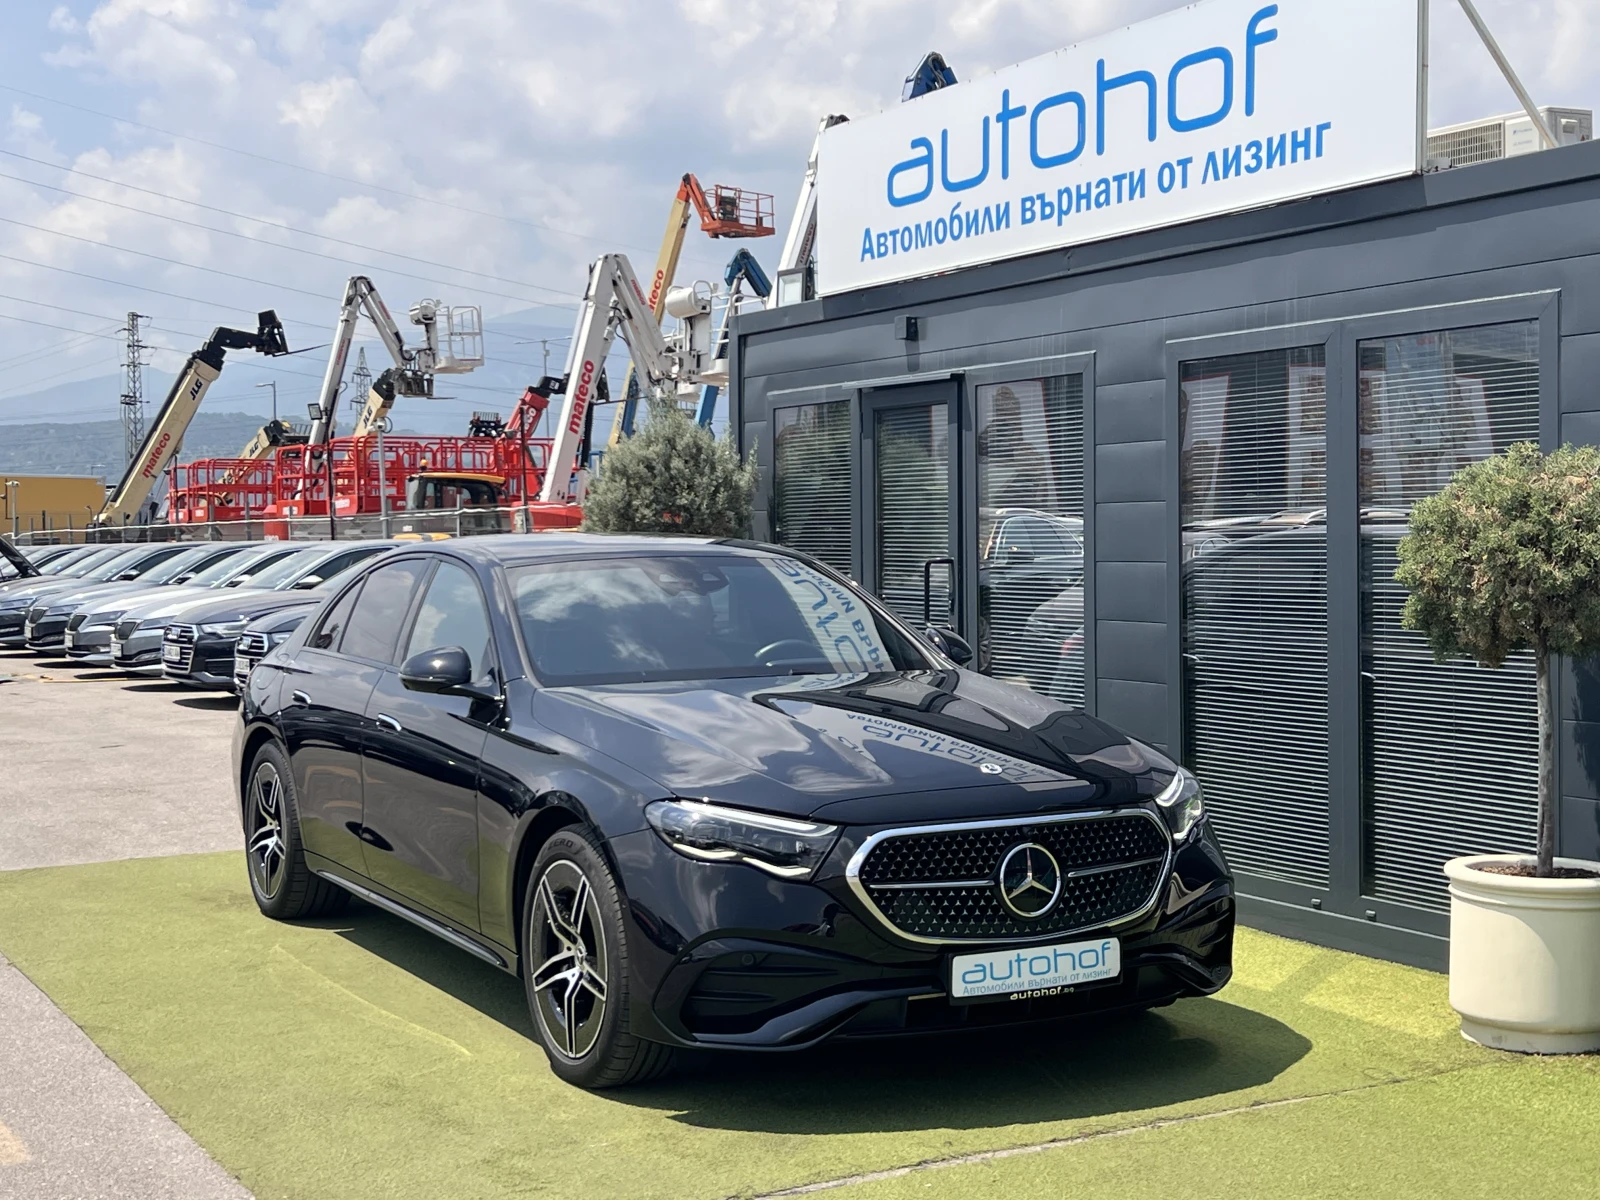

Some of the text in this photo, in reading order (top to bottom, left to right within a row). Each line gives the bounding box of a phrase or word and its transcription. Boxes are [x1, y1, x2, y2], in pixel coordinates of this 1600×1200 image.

[888, 4, 1278, 207] autohof
[860, 121, 1331, 261] Автомобили върнати от лизинг
[190, 378, 203, 401] JLG
[569, 360, 594, 434] mateco
[142, 432, 171, 478] mateco
[961, 941, 1111, 984] autohof
[962, 968, 1112, 996] Автомобили върнати от лизинг
